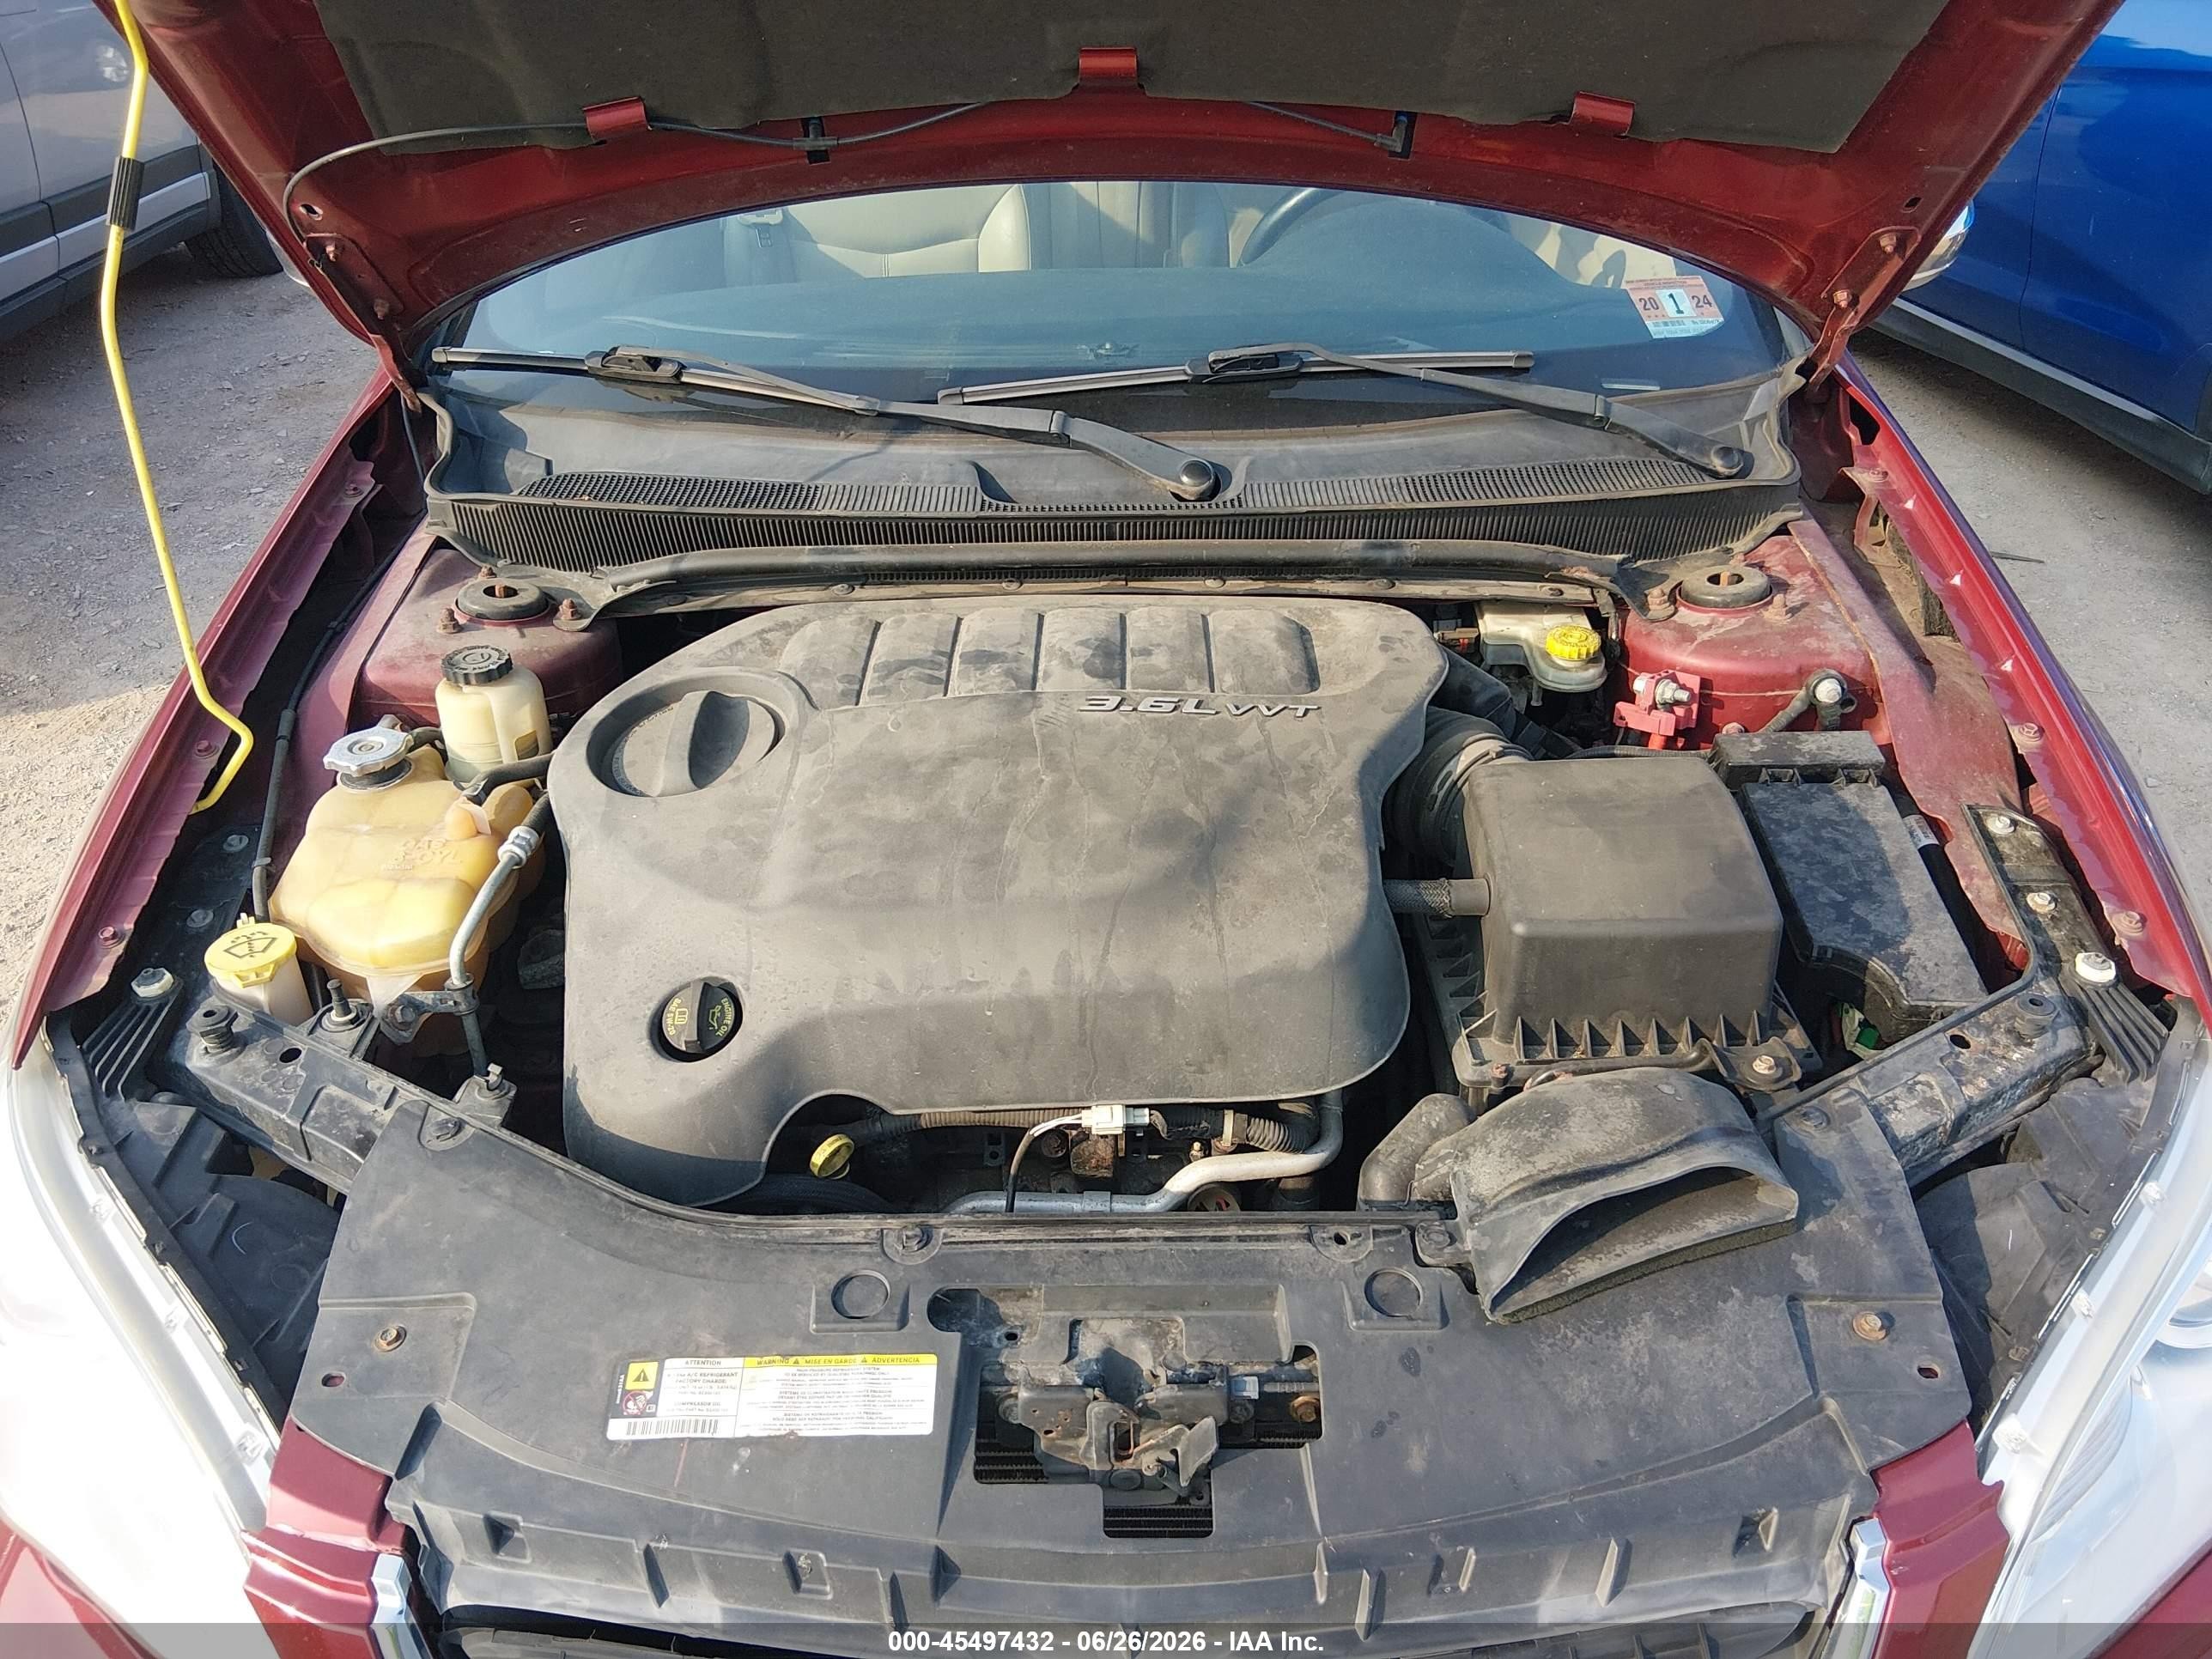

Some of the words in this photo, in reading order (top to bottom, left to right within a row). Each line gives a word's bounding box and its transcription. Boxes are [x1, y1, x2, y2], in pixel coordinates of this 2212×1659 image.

[1638, 296, 1659, 311] 20
[1668, 293, 1684, 314] 1
[1692, 295, 1712, 308] 24
[1078, 696, 1217, 714] 3.6L
[1225, 702, 1320, 717] VVT
[720, 997, 732, 1024] ENGINE
[714, 1025, 728, 1037] OIL
